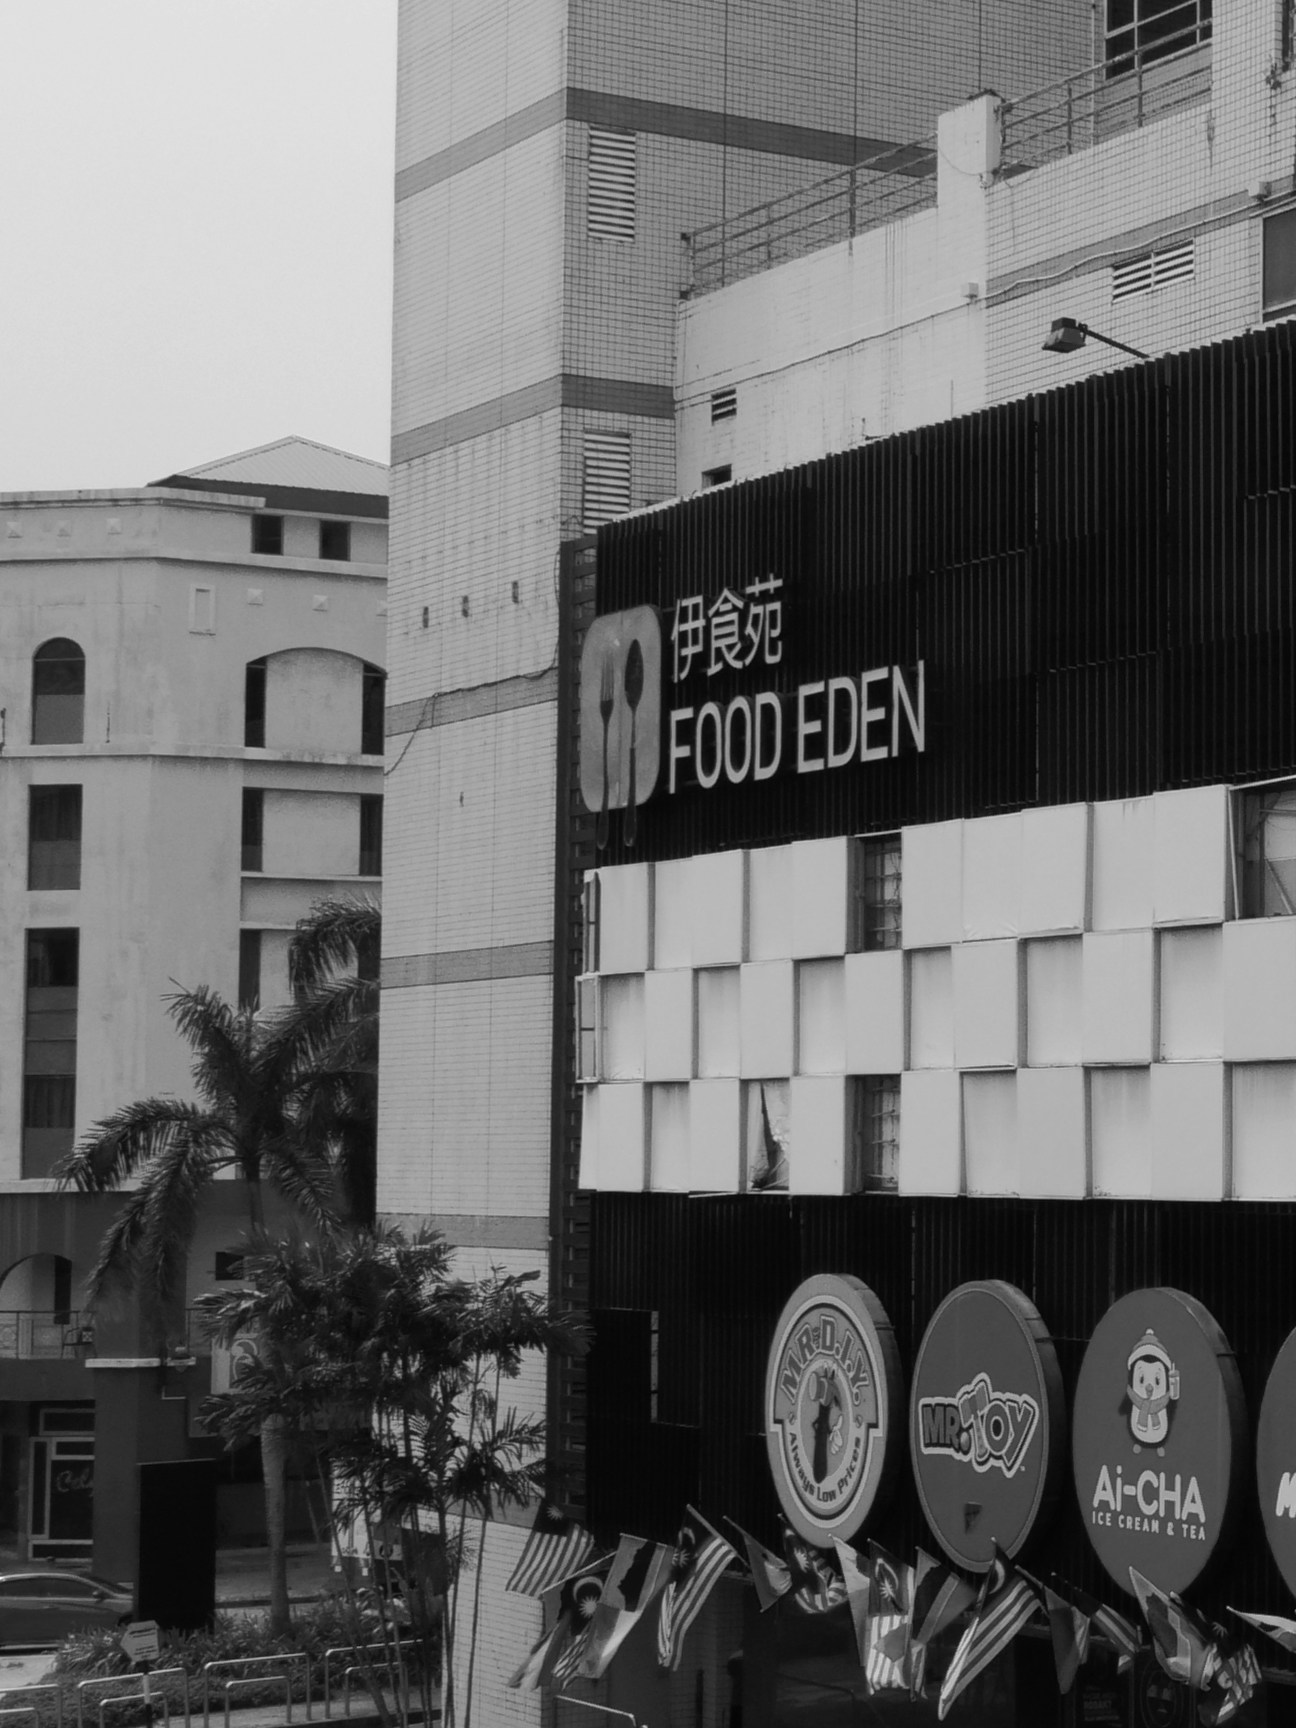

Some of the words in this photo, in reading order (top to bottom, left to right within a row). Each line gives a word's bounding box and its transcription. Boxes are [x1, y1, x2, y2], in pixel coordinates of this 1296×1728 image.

[670, 573, 784, 683] 伊食苑
[668, 691, 783, 794] FOOD
[796, 659, 926, 775] EDEN
[957, 1379, 1037, 1472] TOY
[788, 1432, 815, 1498] Always
[816, 1485, 838, 1503] Low
[837, 1436, 861, 1494] Prices
[1092, 1463, 1207, 1524] Ai-CHA
[1091, 1510, 1113, 1527] ICE
[1117, 1514, 1160, 1534] CREAM
[1166, 1521, 1175, 1536] &
[1181, 1523, 1206, 1541] TEA
